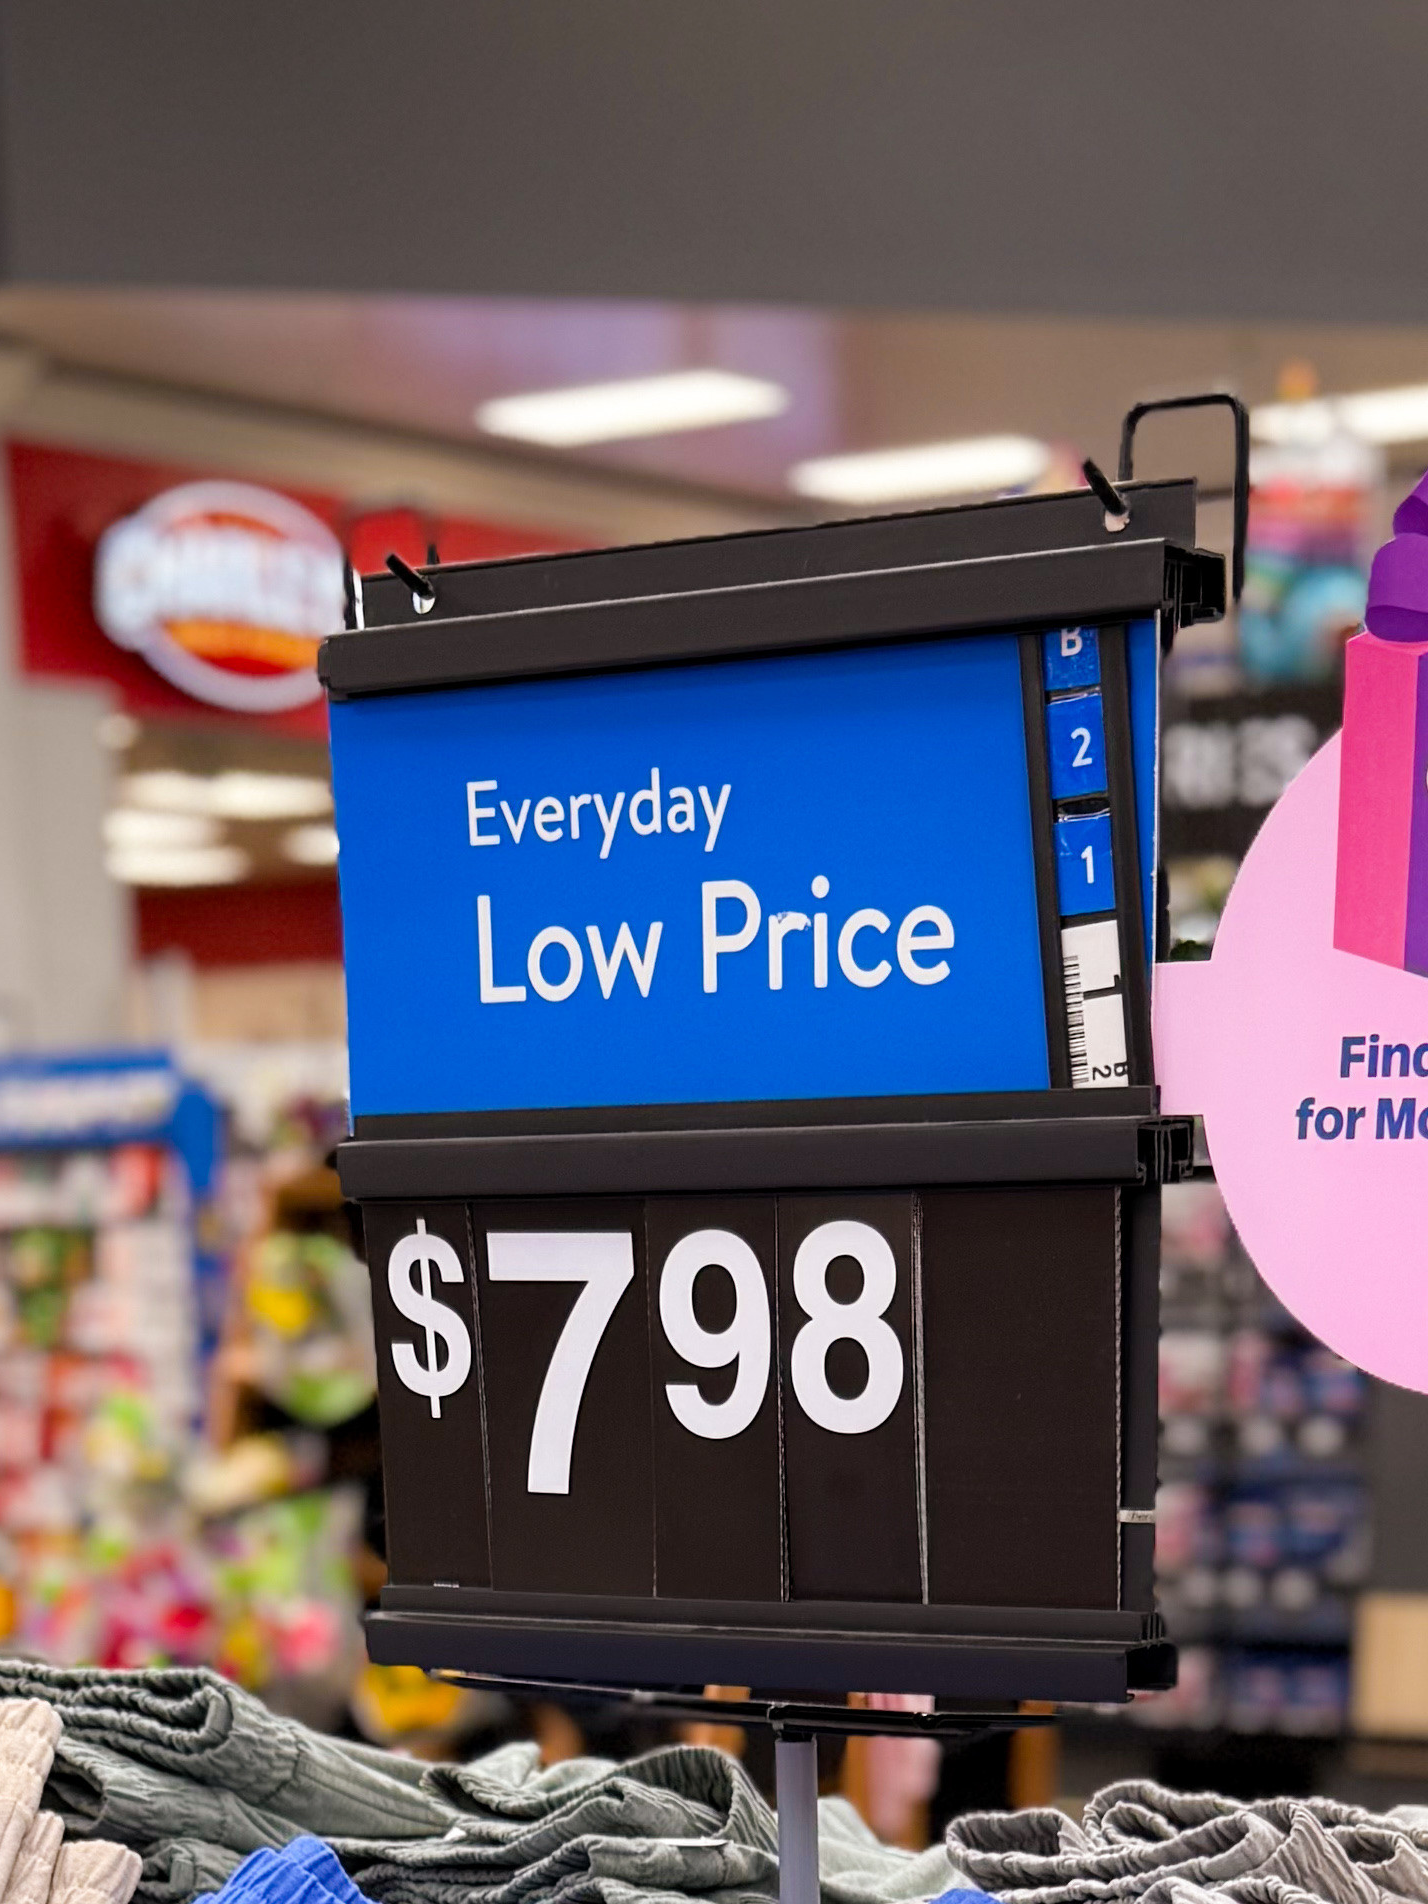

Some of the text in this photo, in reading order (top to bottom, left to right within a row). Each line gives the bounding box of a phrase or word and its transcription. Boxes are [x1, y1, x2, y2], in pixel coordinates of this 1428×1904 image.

[1071, 727, 1092, 768] 2
[467, 767, 732, 859] Everyday
[1081, 845, 1095, 884] 1
[477, 874, 955, 1004] Low Price
[1295, 1097, 1365, 1140] for
